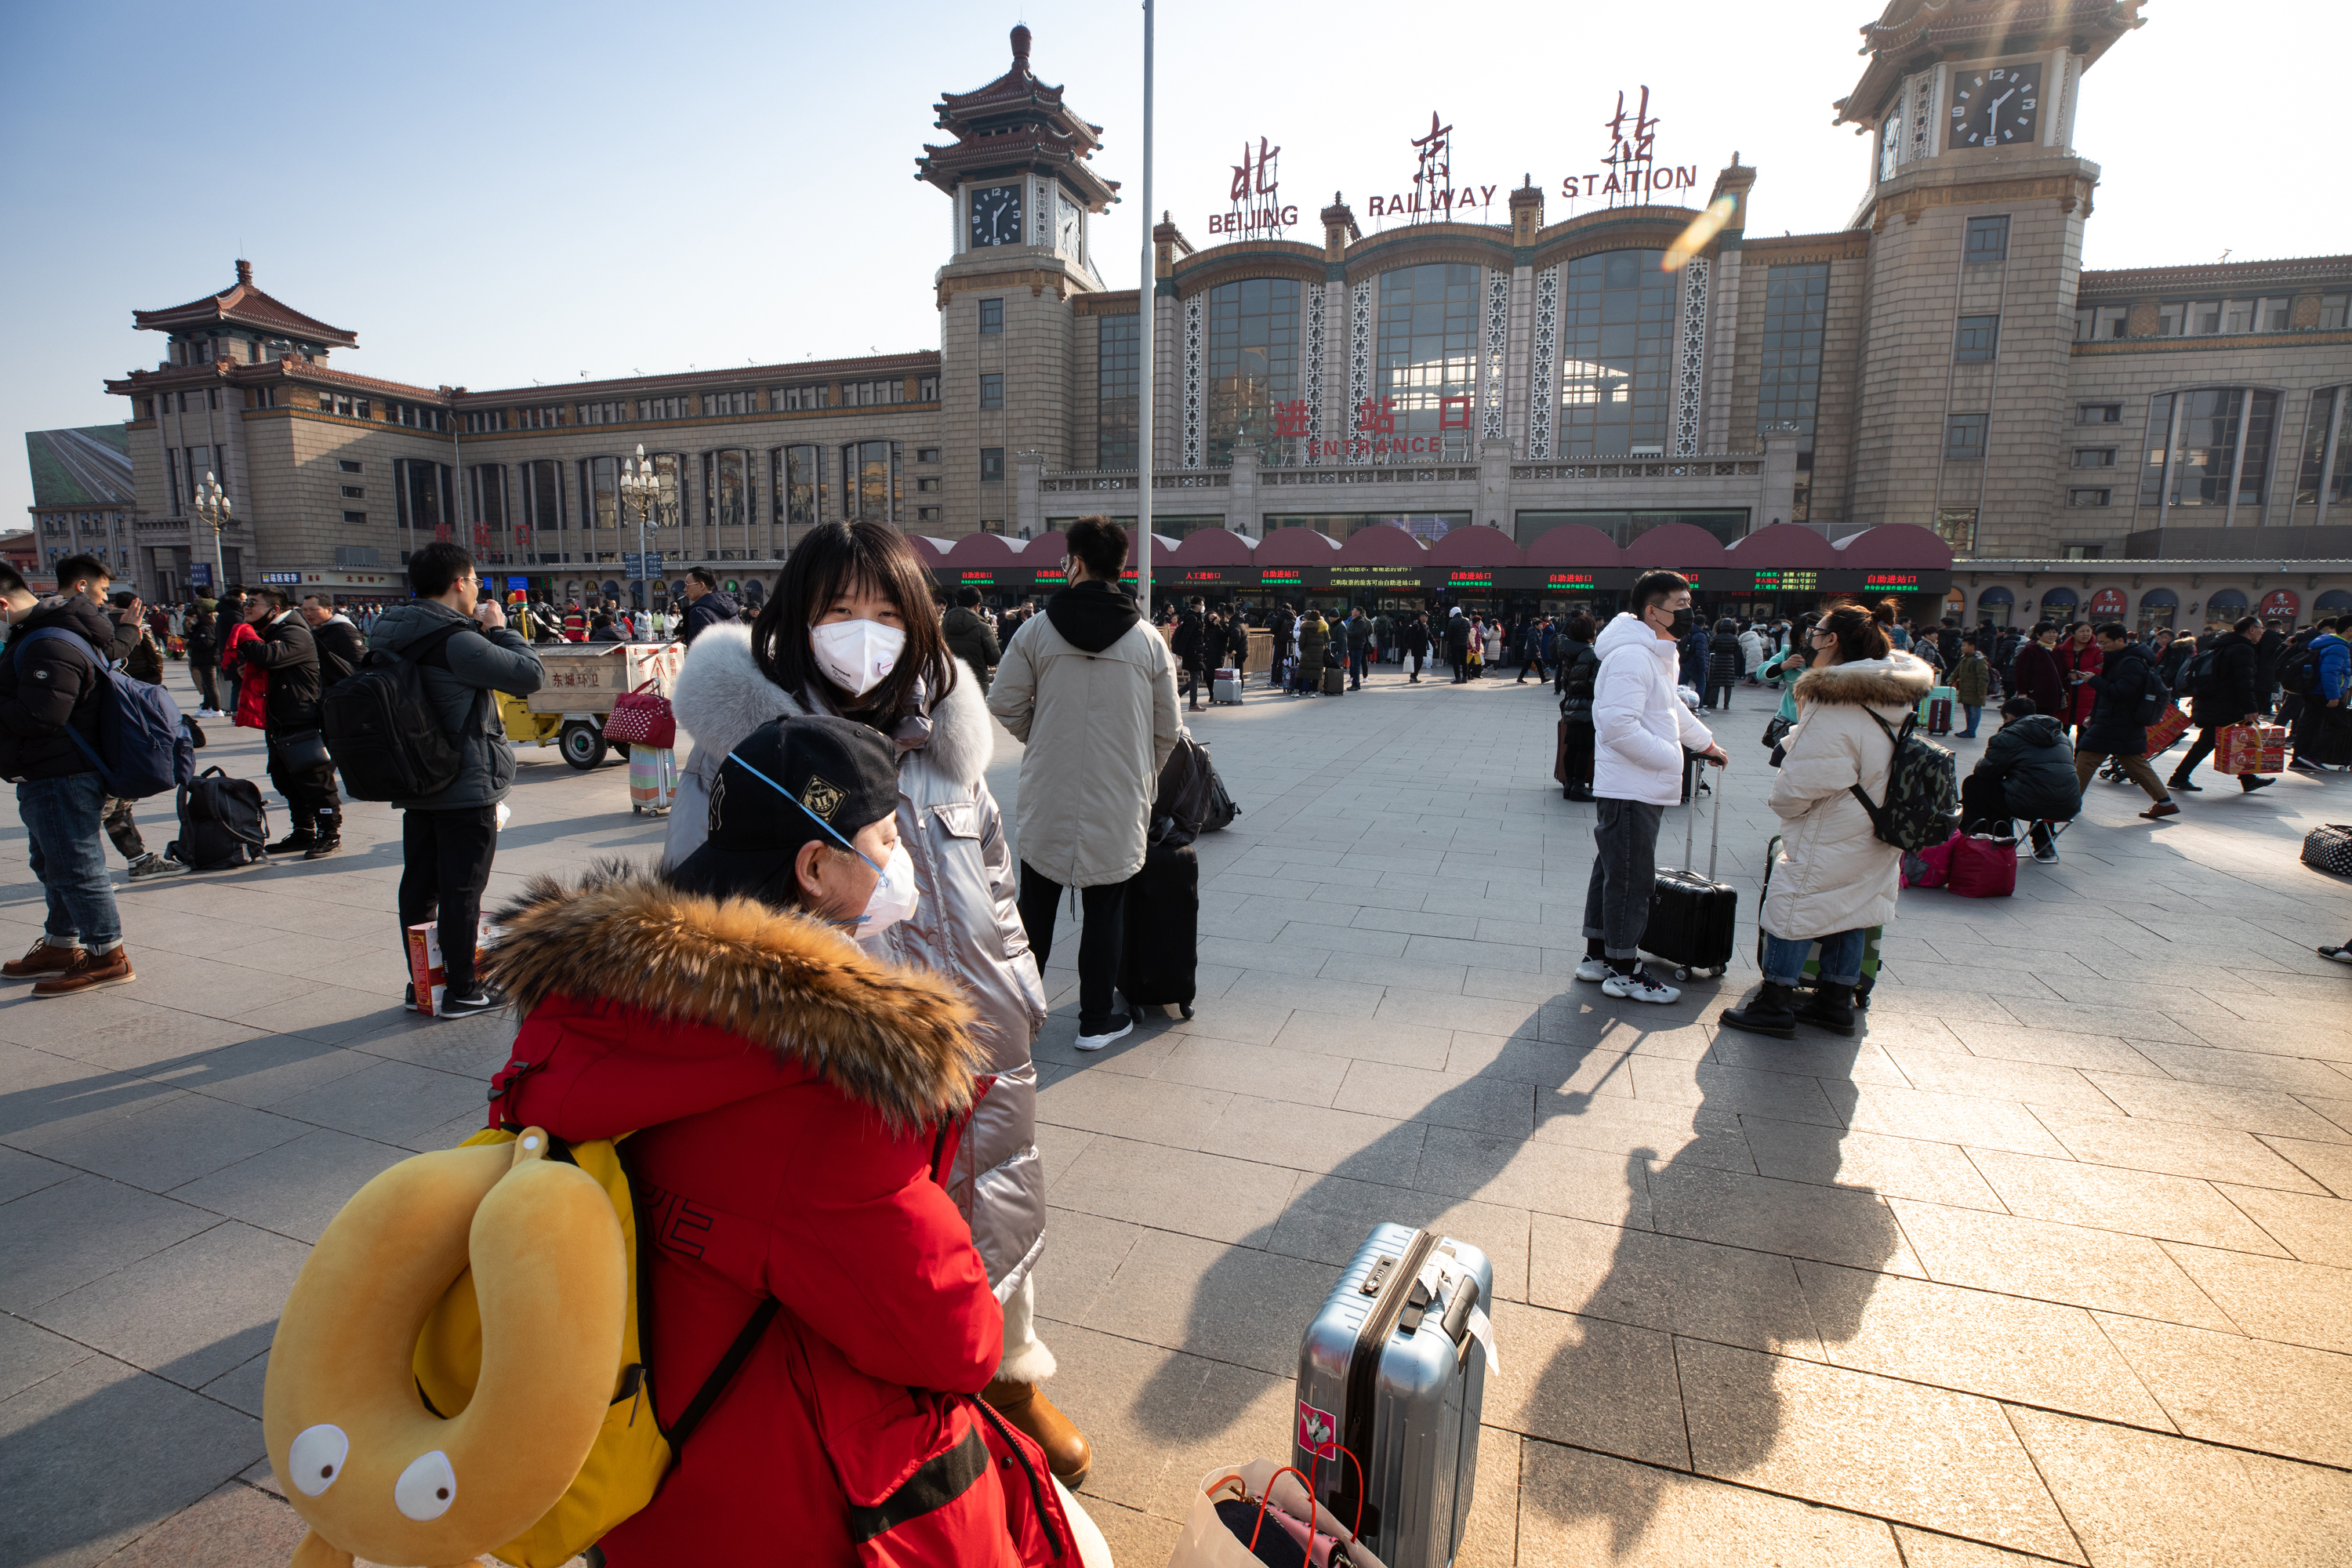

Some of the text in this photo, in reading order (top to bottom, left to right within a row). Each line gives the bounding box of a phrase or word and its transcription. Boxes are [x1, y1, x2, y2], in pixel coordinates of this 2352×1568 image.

[1989, 69, 2005, 81] 12
[2021, 98, 2036, 111] 3
[1951, 106, 1965, 118] 9
[1984, 136, 1997, 147] 6
[992, 187, 1001, 197] 12
[1209, 165, 1697, 234] BEIJING RAILWAY STATION
[972, 215, 981, 224] 9
[1013, 210, 1022, 219] 3
[993, 238, 1001, 246] 6
[1273, 395, 1471, 438] 进站口
[1308, 437, 1440, 456] ENTRANCE
[434, 521, 530, 547] 出站口
[475, 550, 501, 561] XIT
[270, 573, 298, 583] 站区寄存
[1549, 574, 1592, 583] 自助进站口
[1867, 574, 1917, 583] 自助进站口
[552, 673, 600, 688] 东城环卫
